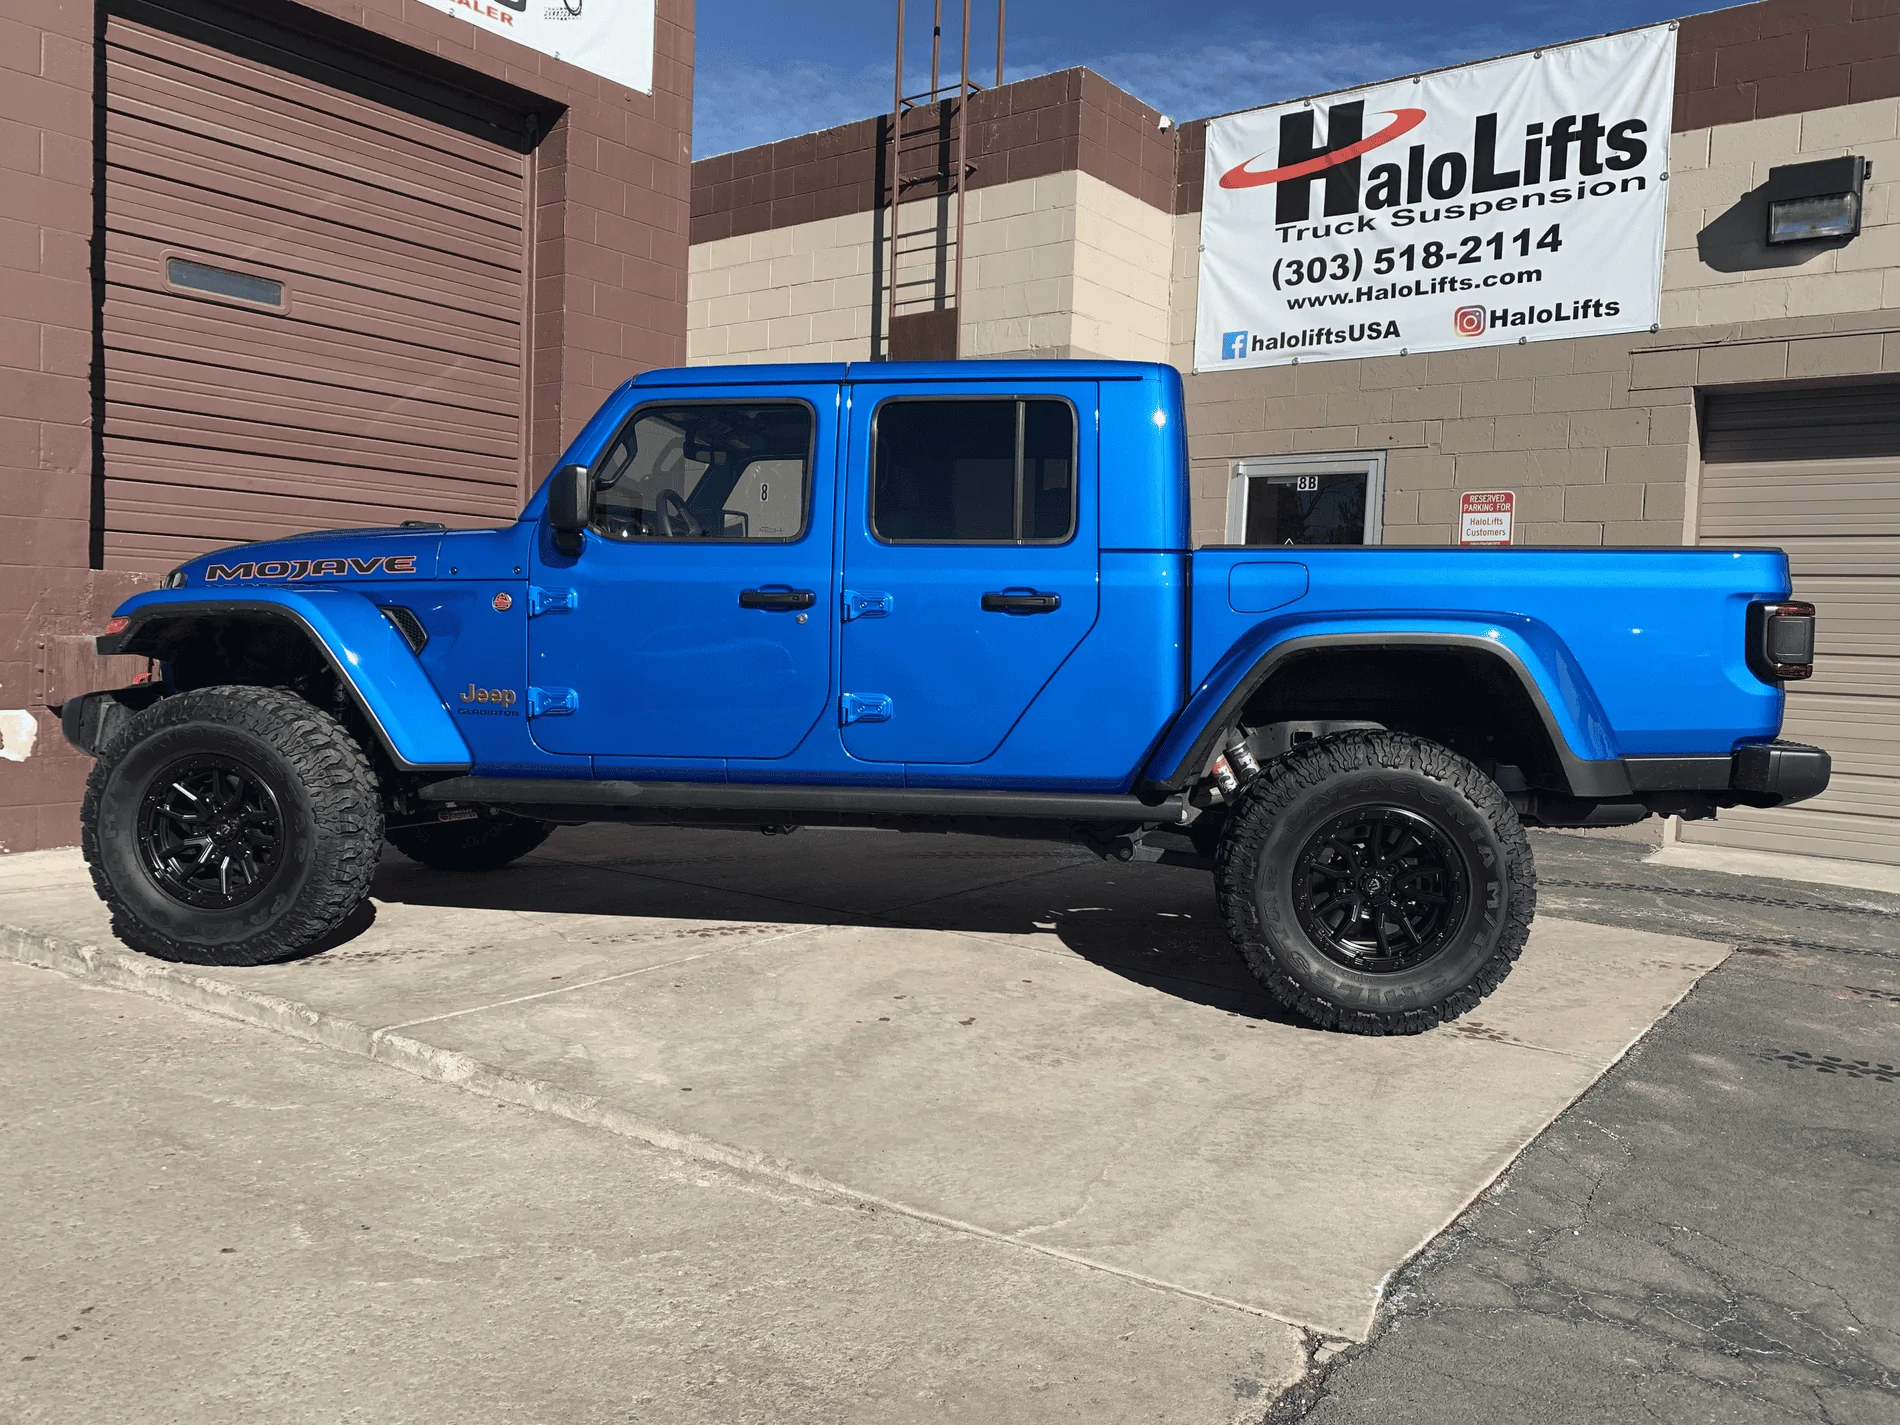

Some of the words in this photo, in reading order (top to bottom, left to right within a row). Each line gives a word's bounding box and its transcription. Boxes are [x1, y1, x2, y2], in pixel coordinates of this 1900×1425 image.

[1275, 100, 1648, 226] HaloLifts
[1275, 214, 1376, 244] Truck
[1391, 175, 1646, 227] Suspension
[1272, 248, 1363, 291] (303)
[1373, 223, 1563, 275] 518-2114
[1287, 266, 1542, 310] www.HaloLifts.com
[1489, 299, 1621, 329] HaloLifts
[1251, 320, 1401, 352] haloliftsUSA
[761, 484, 767, 500] 8
[1299, 477, 1316, 489] 8B
[1497, 503, 1511, 511] FOR
[1470, 517, 1503, 525] HaloLifts
[205, 555, 416, 580] MOJAVE
[460, 683, 516, 707] Jeep
[458, 708, 519, 716] GLADIATOR
